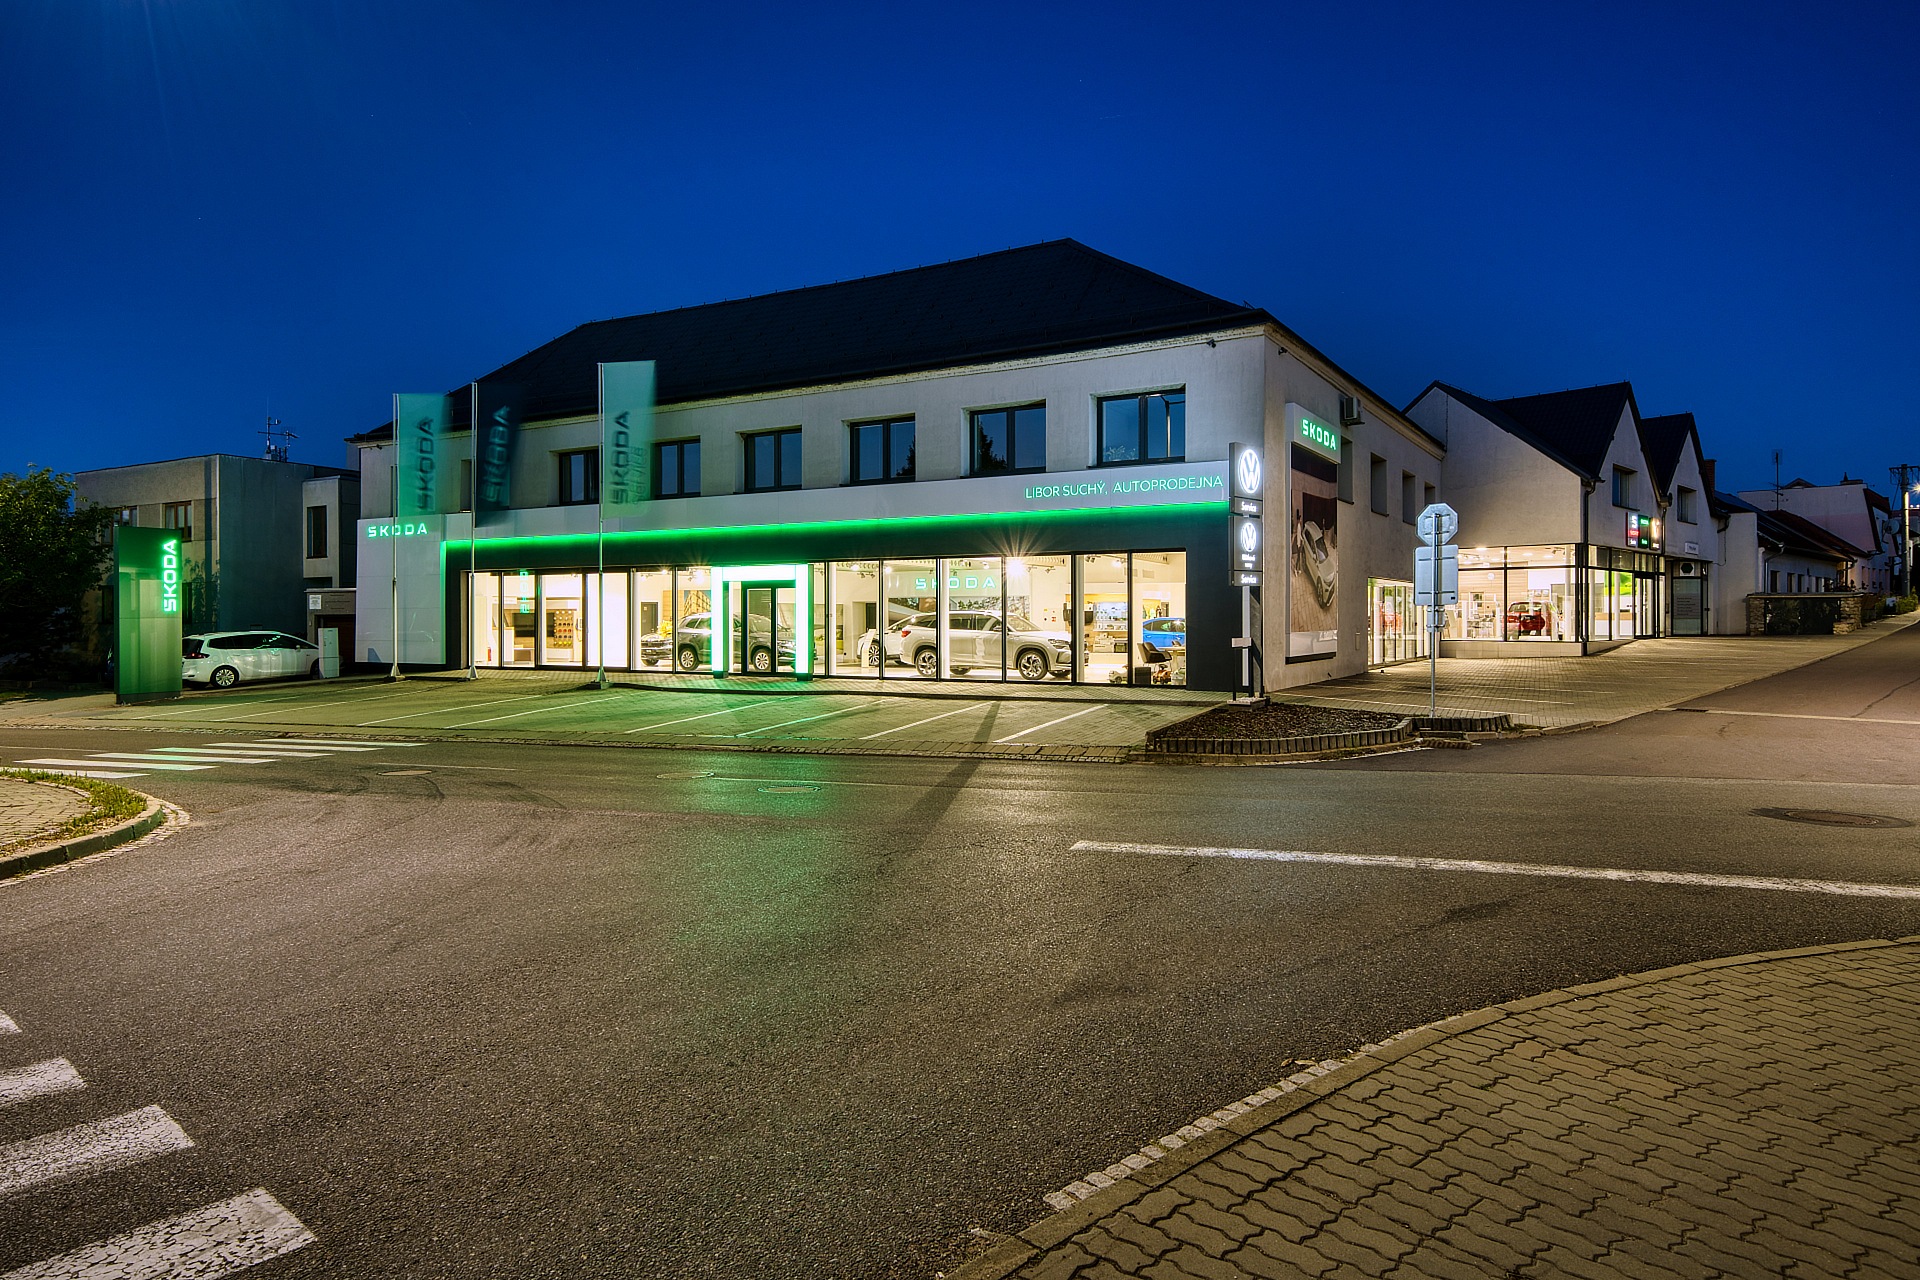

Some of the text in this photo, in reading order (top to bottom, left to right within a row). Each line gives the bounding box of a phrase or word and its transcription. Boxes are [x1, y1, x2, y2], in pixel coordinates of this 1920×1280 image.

[1302, 418, 1336, 451] SKODA
[1025, 475, 1223, 499] LIBOR SUCHÝ, AUTOPRODEJNA
[367, 522, 428, 538] SKODA
[163, 539, 177, 612] SKODA
